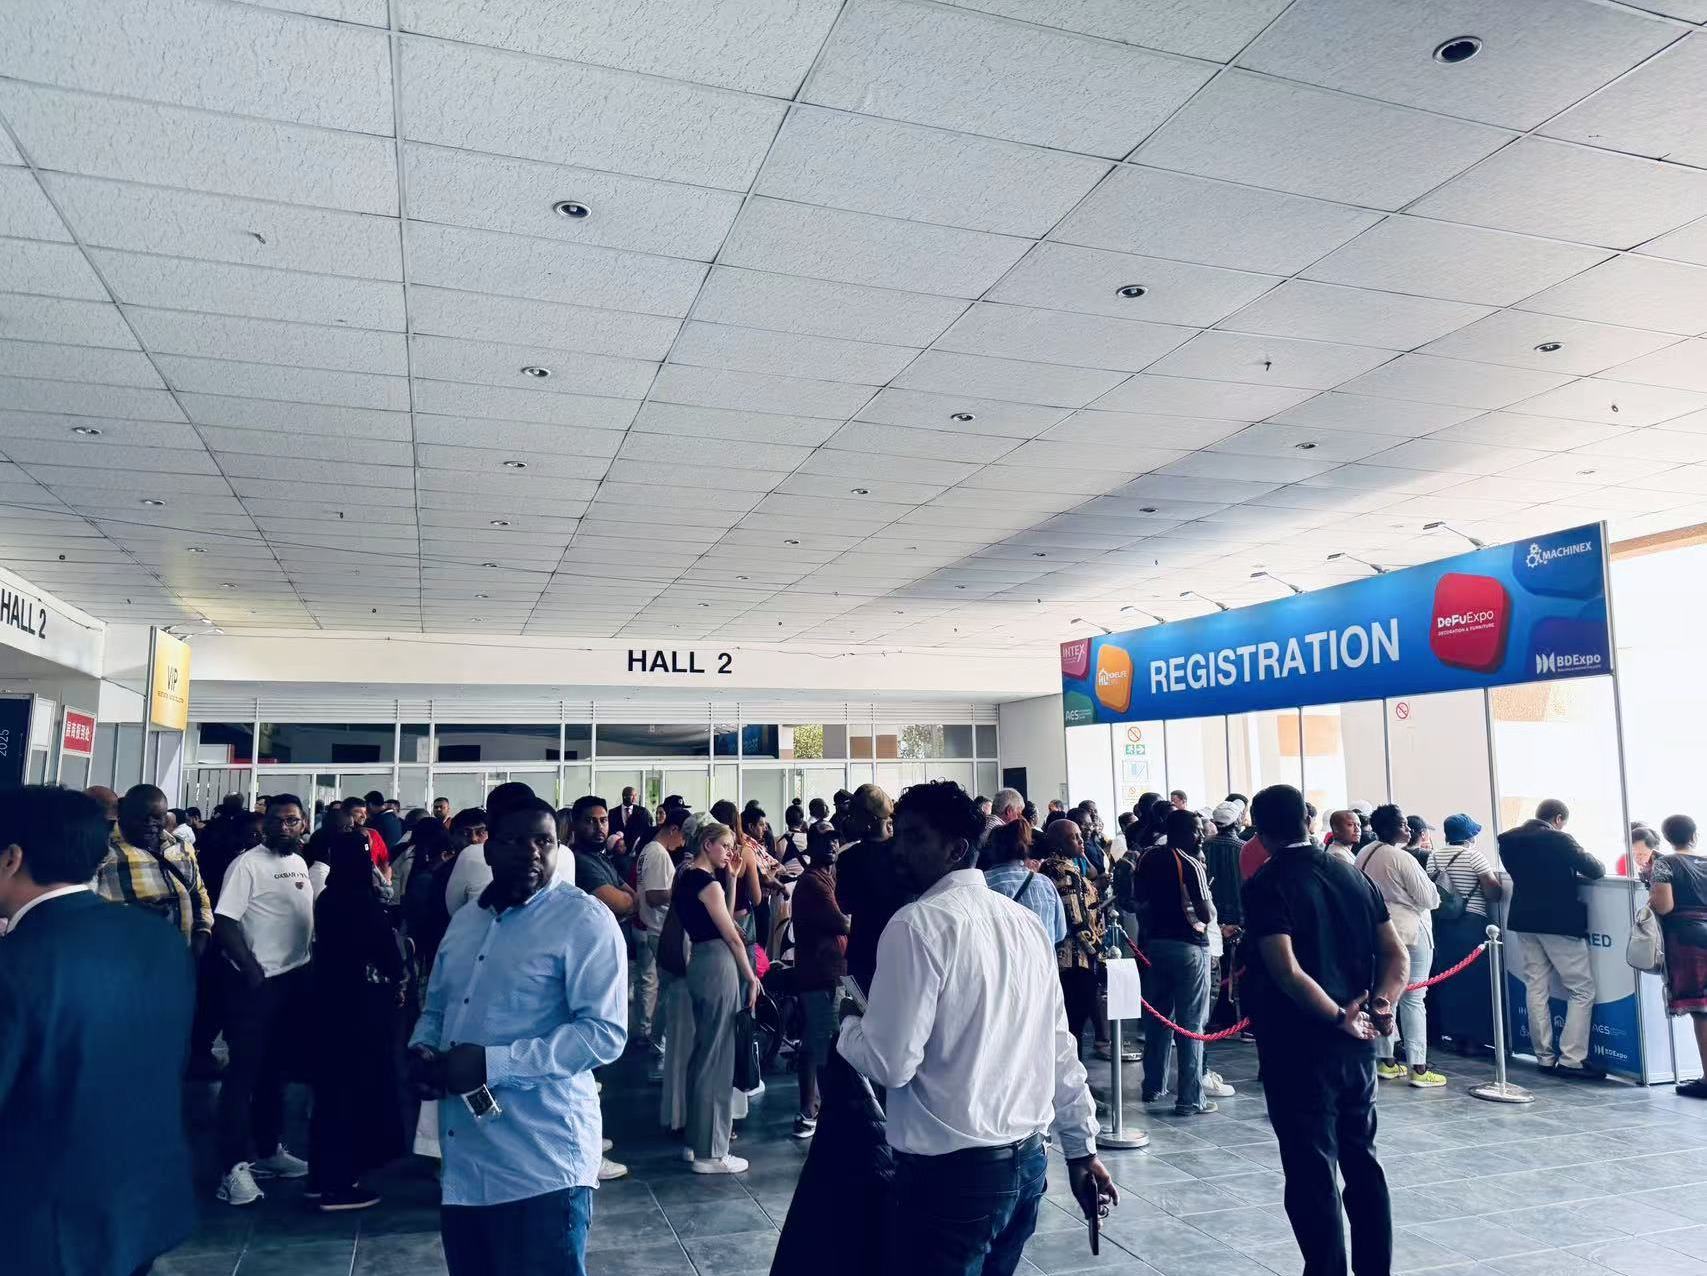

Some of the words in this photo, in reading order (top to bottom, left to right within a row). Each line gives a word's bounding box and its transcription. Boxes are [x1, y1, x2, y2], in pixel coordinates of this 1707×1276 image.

[1542, 541, 1592, 560] MACHINEX
[0, 588, 36, 635] HALL
[38, 608, 47, 640] 2
[1437, 611, 1494, 628] DeFuExpo
[628, 650, 705, 673] HALL
[717, 652, 733, 674] 2
[1062, 644, 1085, 662] INTEX
[1150, 617, 1400, 694] REGISTRATION
[1557, 654, 1601, 667] BDExpo
